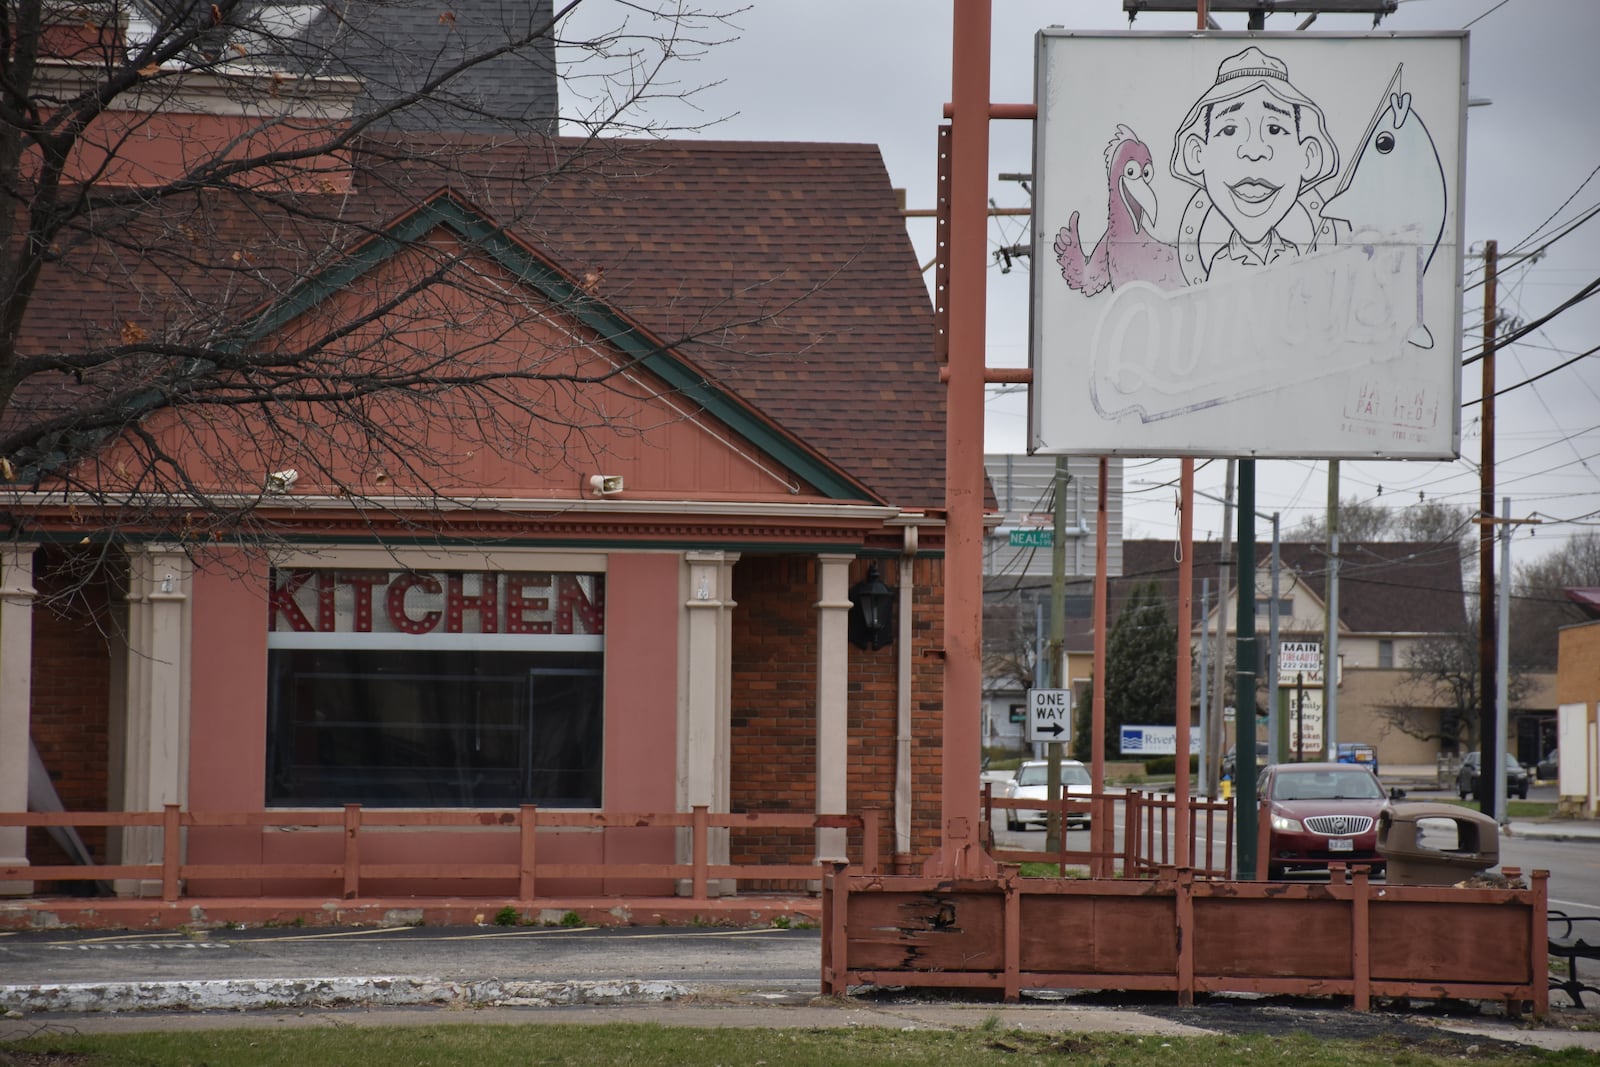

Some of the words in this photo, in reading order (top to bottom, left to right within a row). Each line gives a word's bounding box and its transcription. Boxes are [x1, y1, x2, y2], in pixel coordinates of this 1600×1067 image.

[1010, 533, 1039, 544] NEAL
[268, 569, 605, 634] KITCHEN
[1284, 643, 1317, 652] MAIN
[1037, 693, 1065, 706] ONE
[1291, 699, 1321, 711] Fmily
[1037, 707, 1065, 720] WAY
[1290, 710, 1321, 722] Etery
